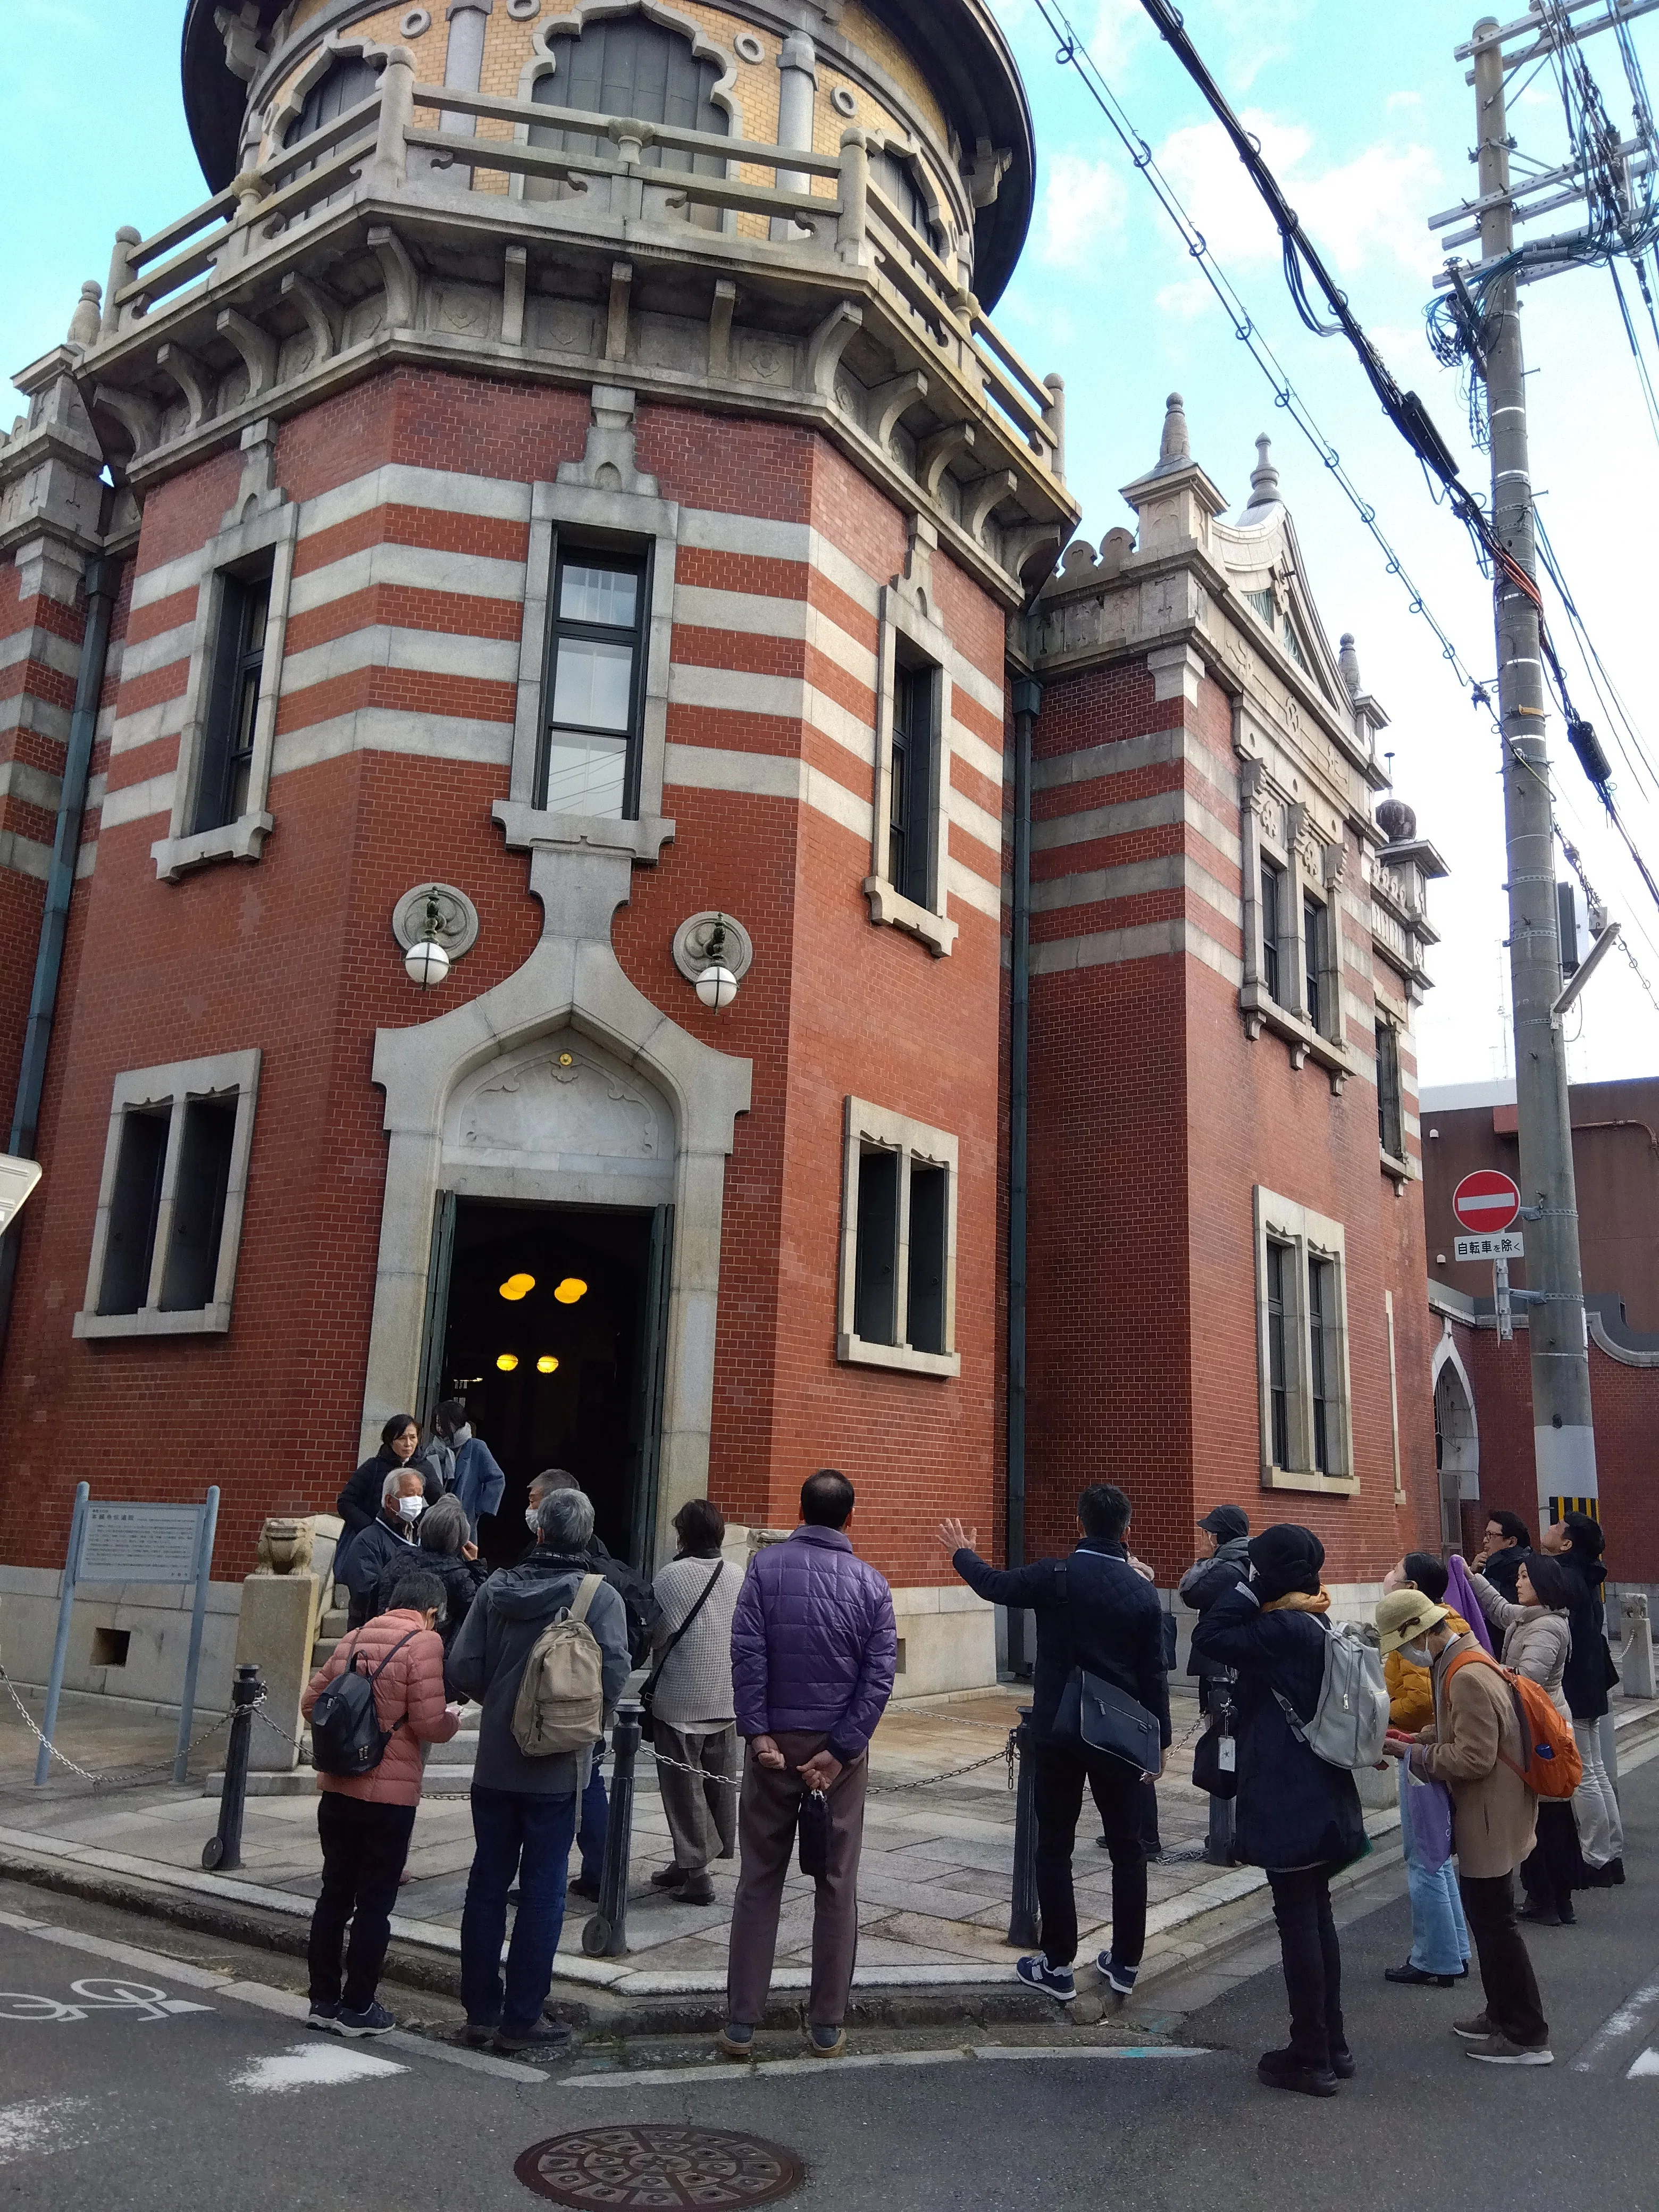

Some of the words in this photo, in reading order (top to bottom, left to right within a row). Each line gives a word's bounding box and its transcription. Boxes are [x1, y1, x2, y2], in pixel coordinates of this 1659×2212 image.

[1458, 1238, 1520, 1255] 自転車を除く
